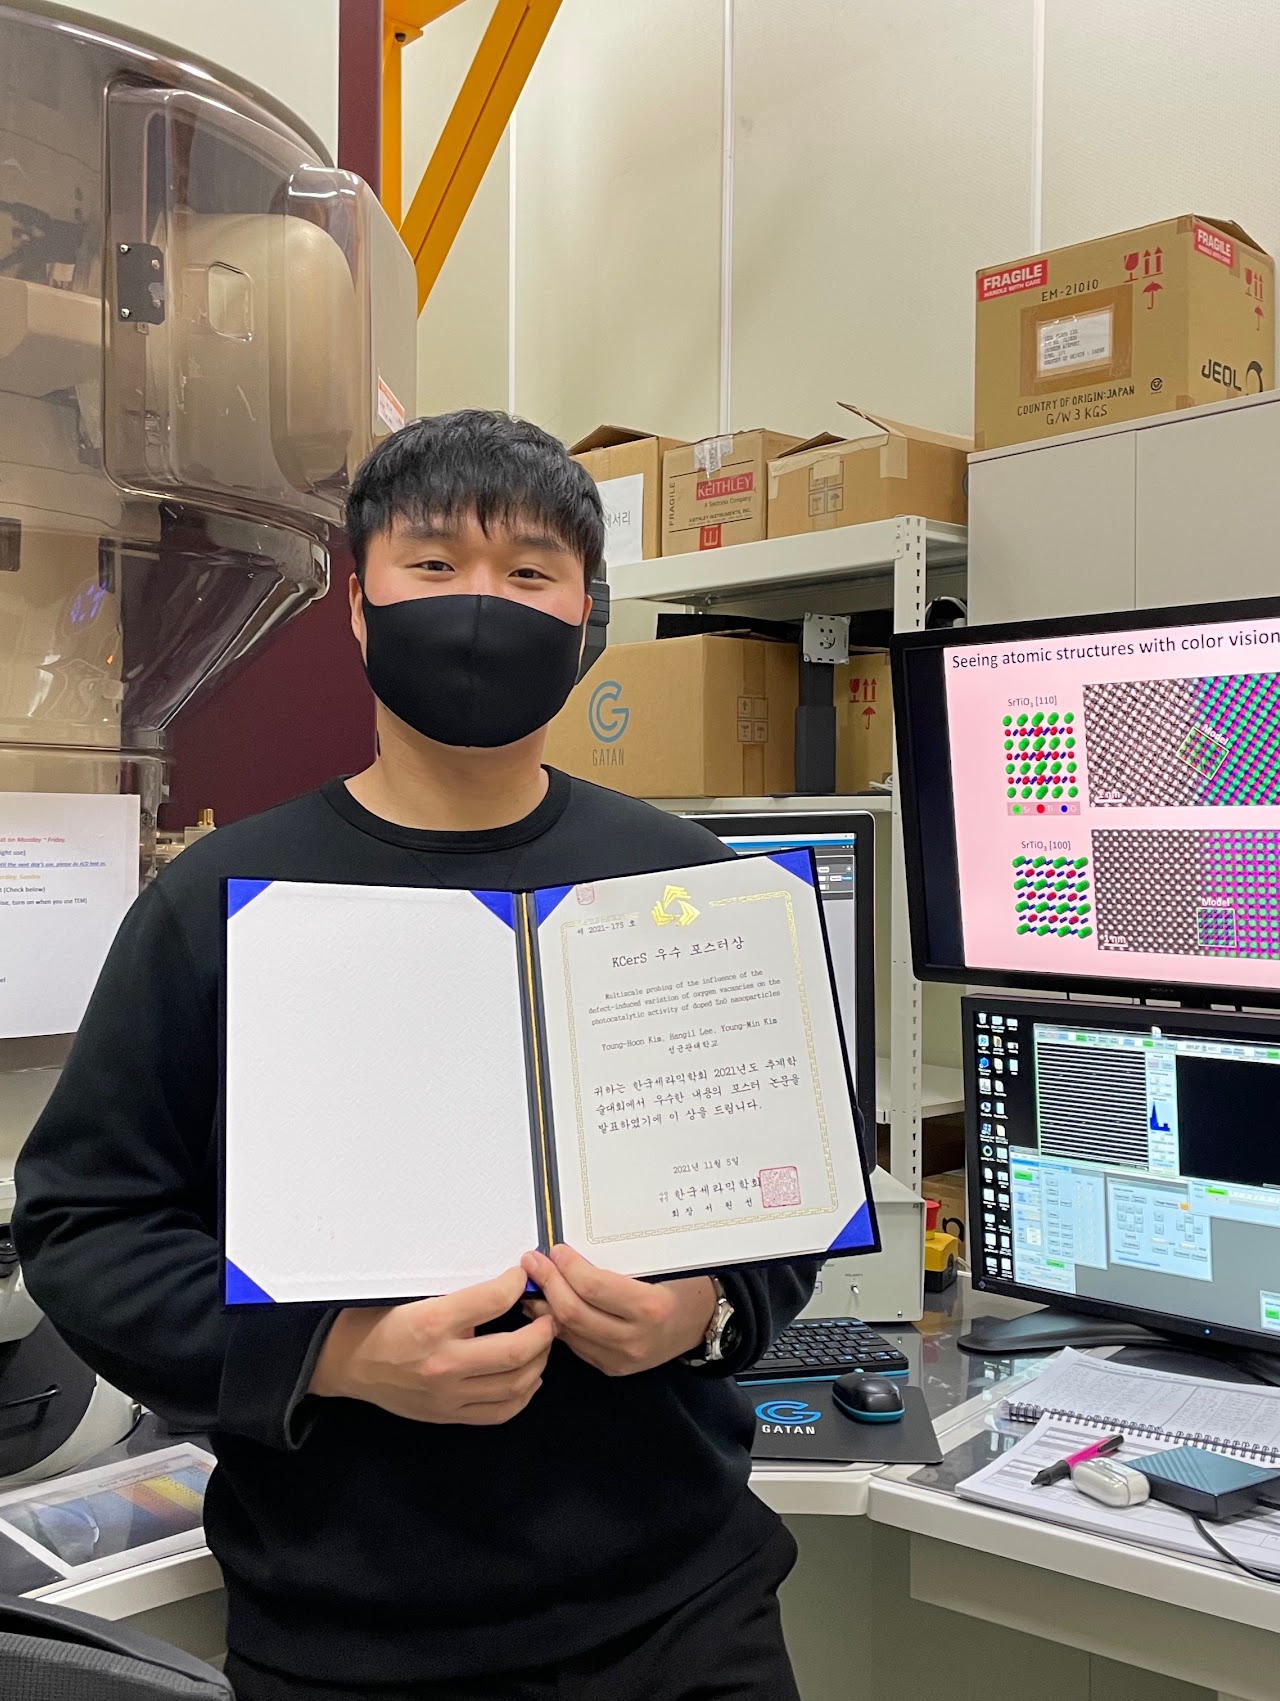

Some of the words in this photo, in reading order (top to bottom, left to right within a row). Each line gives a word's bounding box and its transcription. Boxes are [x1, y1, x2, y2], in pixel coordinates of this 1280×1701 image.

[1197, 229, 1232, 257] FRAGILE
[983, 263, 1043, 291] FRAGILE
[984, 287, 1008, 298] HANDLE
[1008, 282, 1024, 293] WITH
[1025, 278, 1041, 287] CARE
[1041, 279, 1099, 301] EM-21010
[1201, 359, 1242, 391] JEOL
[1017, 399, 1058, 416] COUNTRY
[1060, 396, 1071, 408] OF
[1046, 411, 1071, 426] G/W
[1074, 408, 1081, 421] 3
[1085, 404, 1108, 420] KGS
[697, 475, 752, 498] KEITHLEY
[729, 496, 752, 504] Company
[952, 653, 998, 669] Seeing
[1002, 647, 1052, 665] atomic
[1056, 643, 1134, 661] structures
[1139, 637, 1176, 654] with
[1181, 634, 1224, 650] color
[1229, 629, 1280, 647] vision
[1035, 695, 1058, 706] [110]
[1201, 723, 1229, 745] Model
[592, 748, 625, 766] GATAN
[17, 836, 42, 844] Monday
[1049, 840, 1071, 851] [100]
[1201, 897, 1230, 907] Model
[611, 952, 648, 968] KCerS
[655, 946, 681, 961] 우수
[690, 936, 744, 956] 포스터상
[605, 989, 643, 1000] Multiscale
[646, 984, 673, 995] probing
[675, 981, 683, 989] of
[687, 979, 699, 987] the
[702, 974, 737, 985] influence
[740, 971, 747, 979] of
[588, 999, 642, 1014] defect-induced
[645, 994, 679, 1006] variation
[693, 989, 717, 998] oxygen
[719, 982, 754, 993] vacancies
[591, 1012, 645, 1026] photocatalytic
[648, 1006, 678, 1016] activity
[682, 1003, 690, 1011] of
[693, 1001, 713, 1010] doped
[730, 990, 781, 1004] nanoparticles
[601, 1039, 645, 1052] Young-Hoon
[669, 1029, 696, 1041] Hangil
[720, 1020, 761, 1033] Young-Min
[763, 1017, 778, 1026] Kim
[594, 1083, 626, 1097] 귀하는
[633, 1069, 708, 1092] 한국세라믹학회
[713, 1063, 759, 1078] 2021년도
[765, 1055, 797, 1070] 추계학
[595, 1097, 645, 1116] 술대회에서
[653, 1091, 685, 1107] 우수한
[692, 1085, 722, 1100] 내용의
[731, 1079, 760, 1095] 포스터
[768, 1073, 800, 1088] 논문을
[598, 1113, 662, 1135] 발표하였기에
[669, 1110, 679, 1122] 이
[685, 1106, 707, 1121] 상을
[714, 1099, 762, 1116] 드립니다.
[673, 1162, 699, 1175] 2021년
[704, 1159, 721, 1170] 11월
[761, 1424, 816, 1435] GATAN
